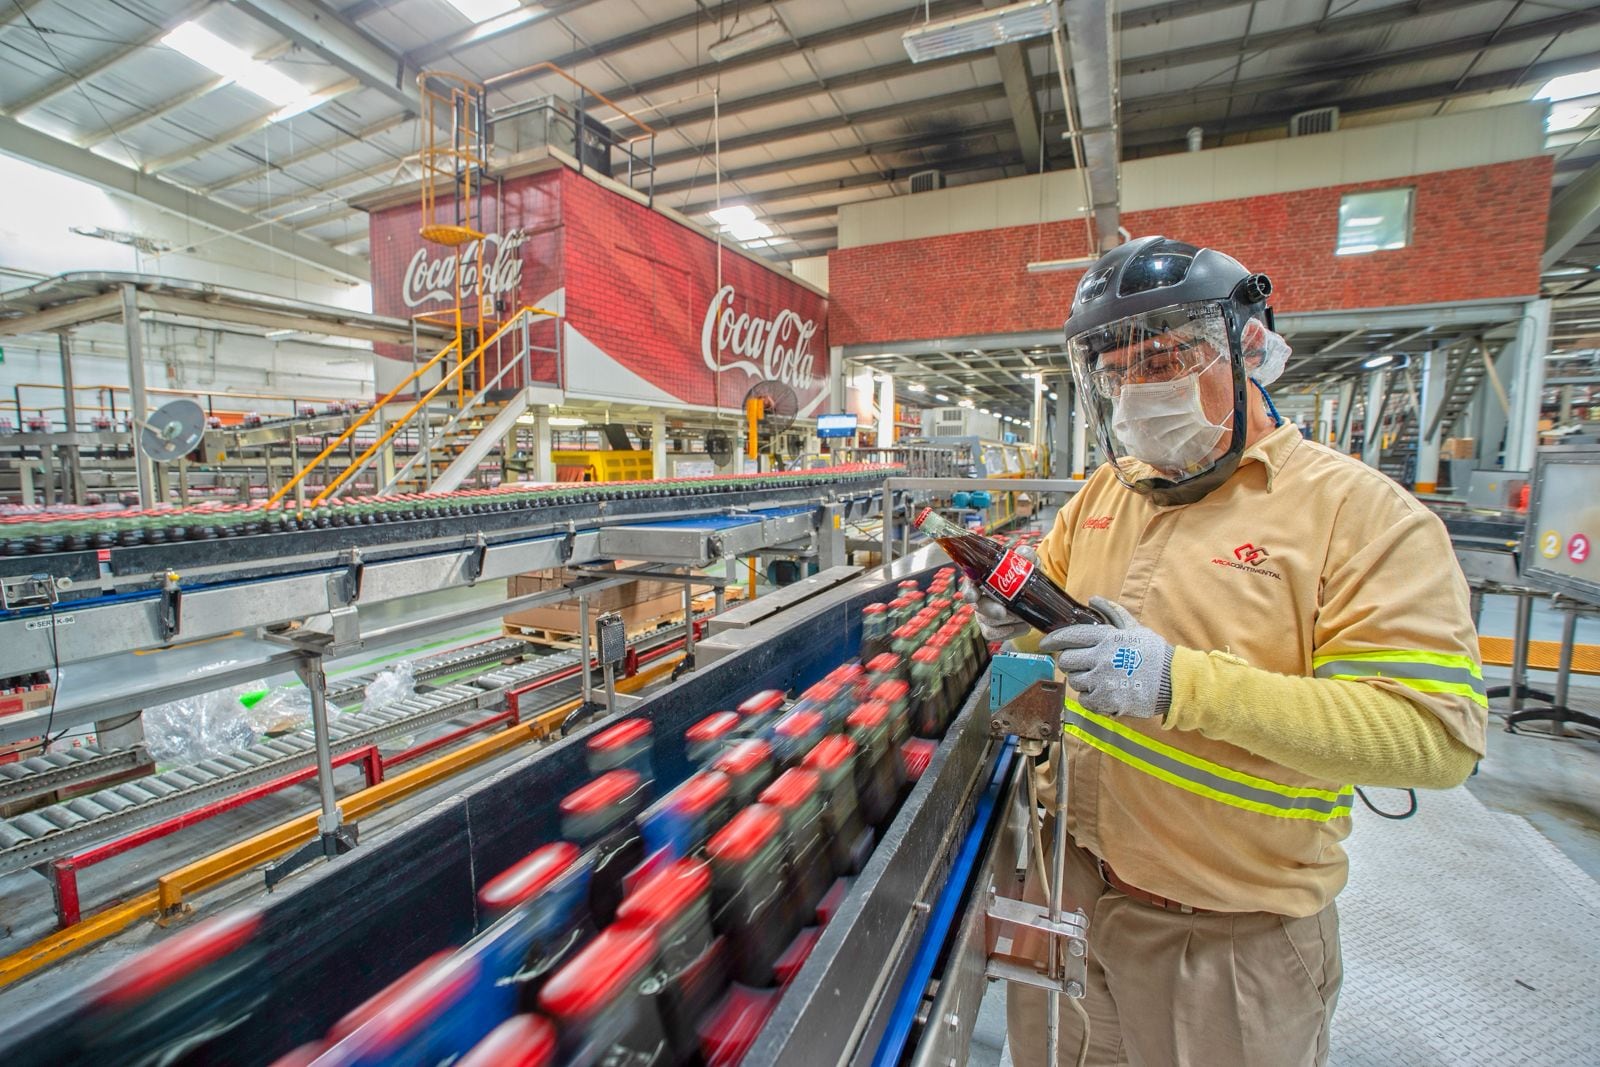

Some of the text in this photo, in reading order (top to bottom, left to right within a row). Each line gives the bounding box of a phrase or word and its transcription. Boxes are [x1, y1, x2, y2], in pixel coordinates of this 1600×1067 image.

[701, 284, 818, 389] Coca-Cola
[1543, 535, 1586, 560] 2 2
